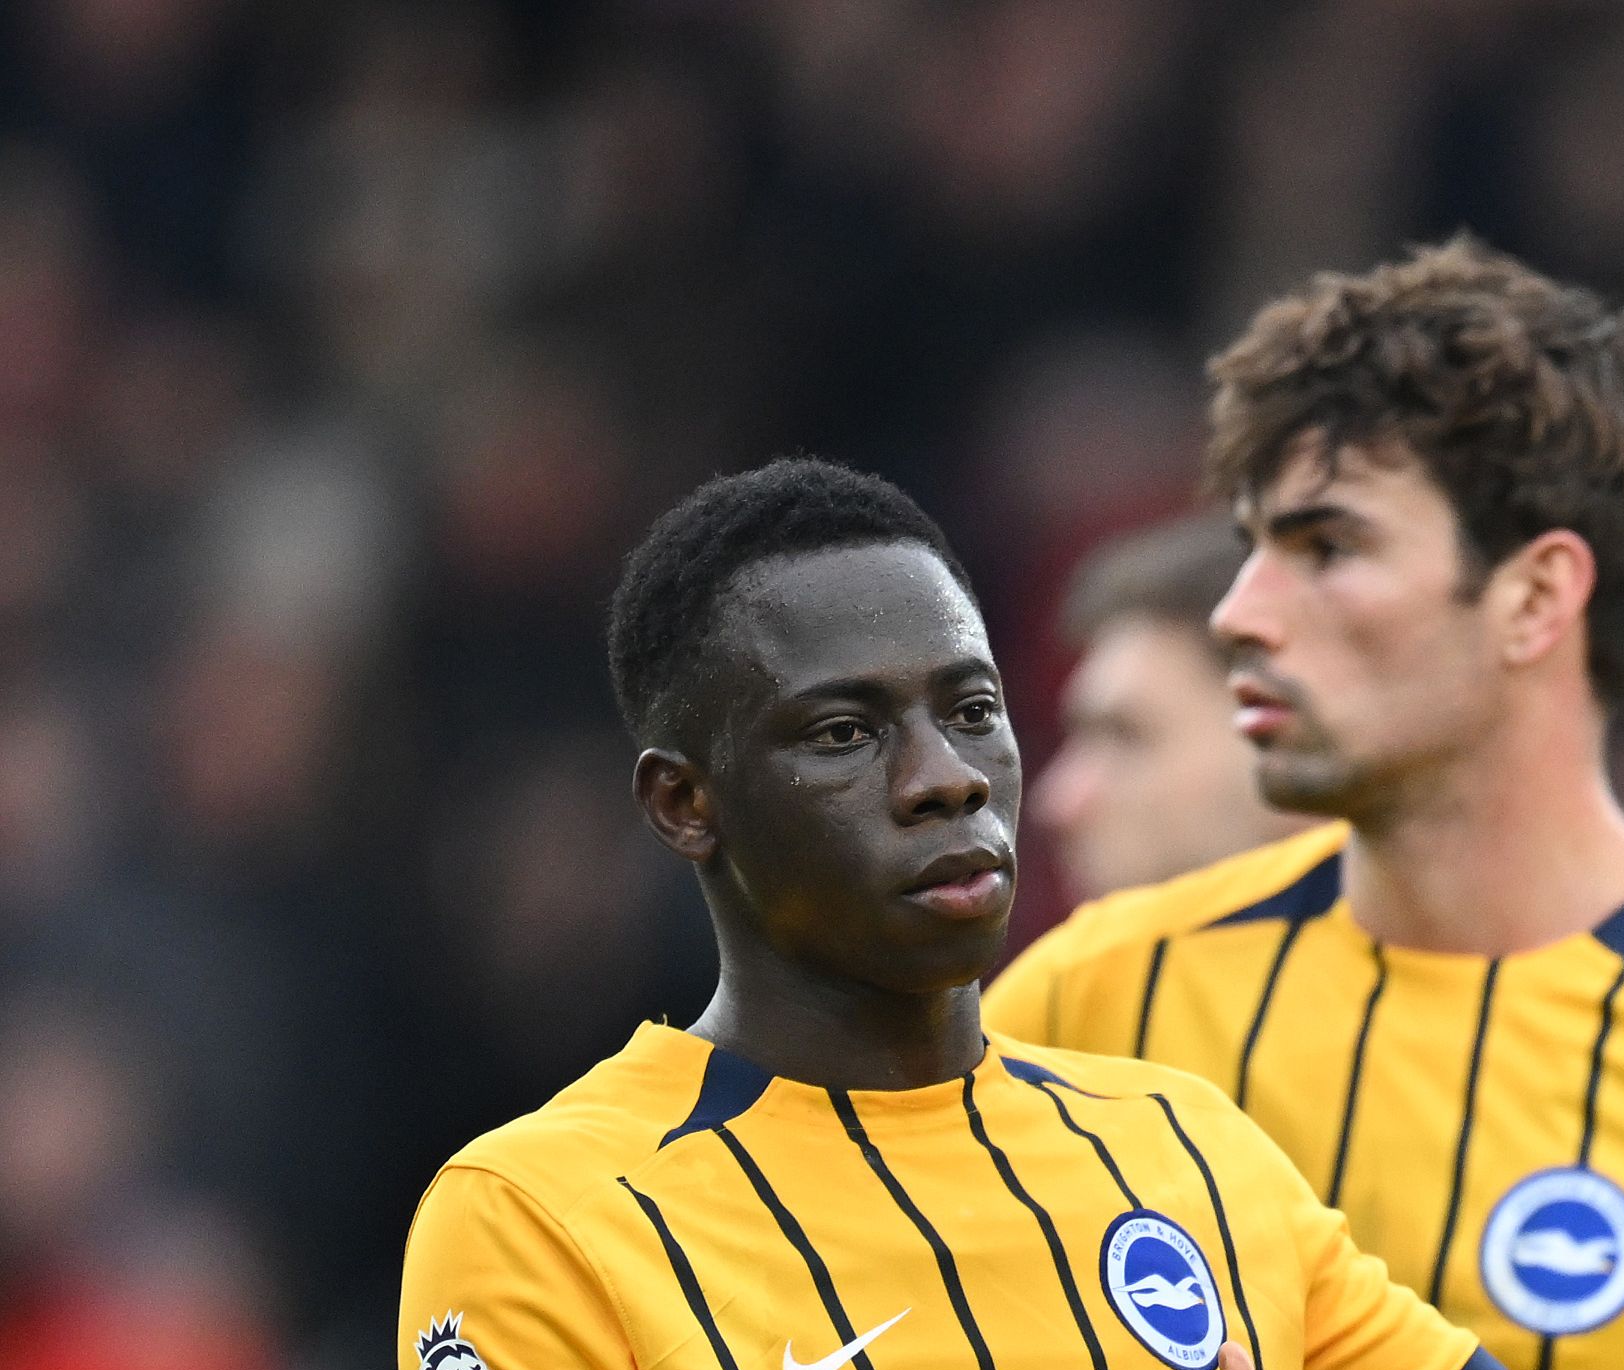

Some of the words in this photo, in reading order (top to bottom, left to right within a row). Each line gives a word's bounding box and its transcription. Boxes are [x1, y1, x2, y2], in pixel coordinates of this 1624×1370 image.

[1112, 1222, 1151, 1262] BRIGHTON
[1156, 1226, 1165, 1237] &
[1169, 1231, 1198, 1265] HOVE
[1167, 1344, 1207, 1361] ALBION
